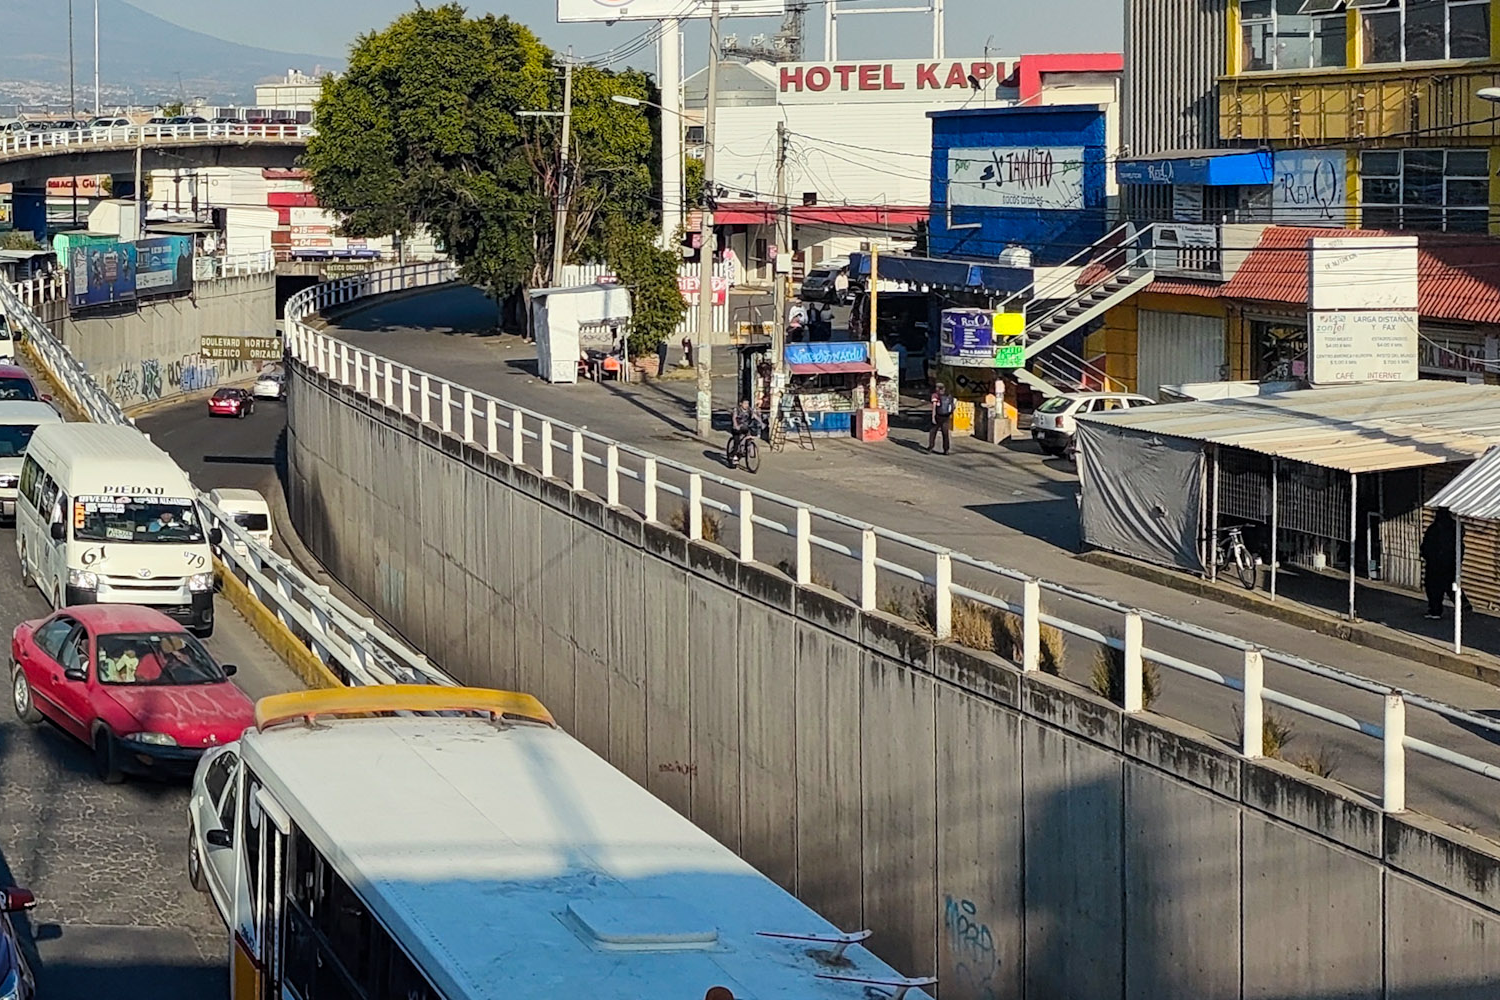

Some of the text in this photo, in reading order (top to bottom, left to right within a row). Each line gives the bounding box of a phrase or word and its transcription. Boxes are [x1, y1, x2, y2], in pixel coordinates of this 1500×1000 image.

[780, 63, 905, 92] HOTEL
[1006, 148, 1053, 191] TAQUITO
[1378, 315, 1414, 323] DISTANCIA
[202, 337, 270, 348] BOULEVARD NORTE
[212, 348, 281, 359] MEXICO ORIZABA
[1336, 371, 1354, 379] CAFÉ
[103, 486, 165, 495] PIEDAD
[81, 545, 107, 566] 61
